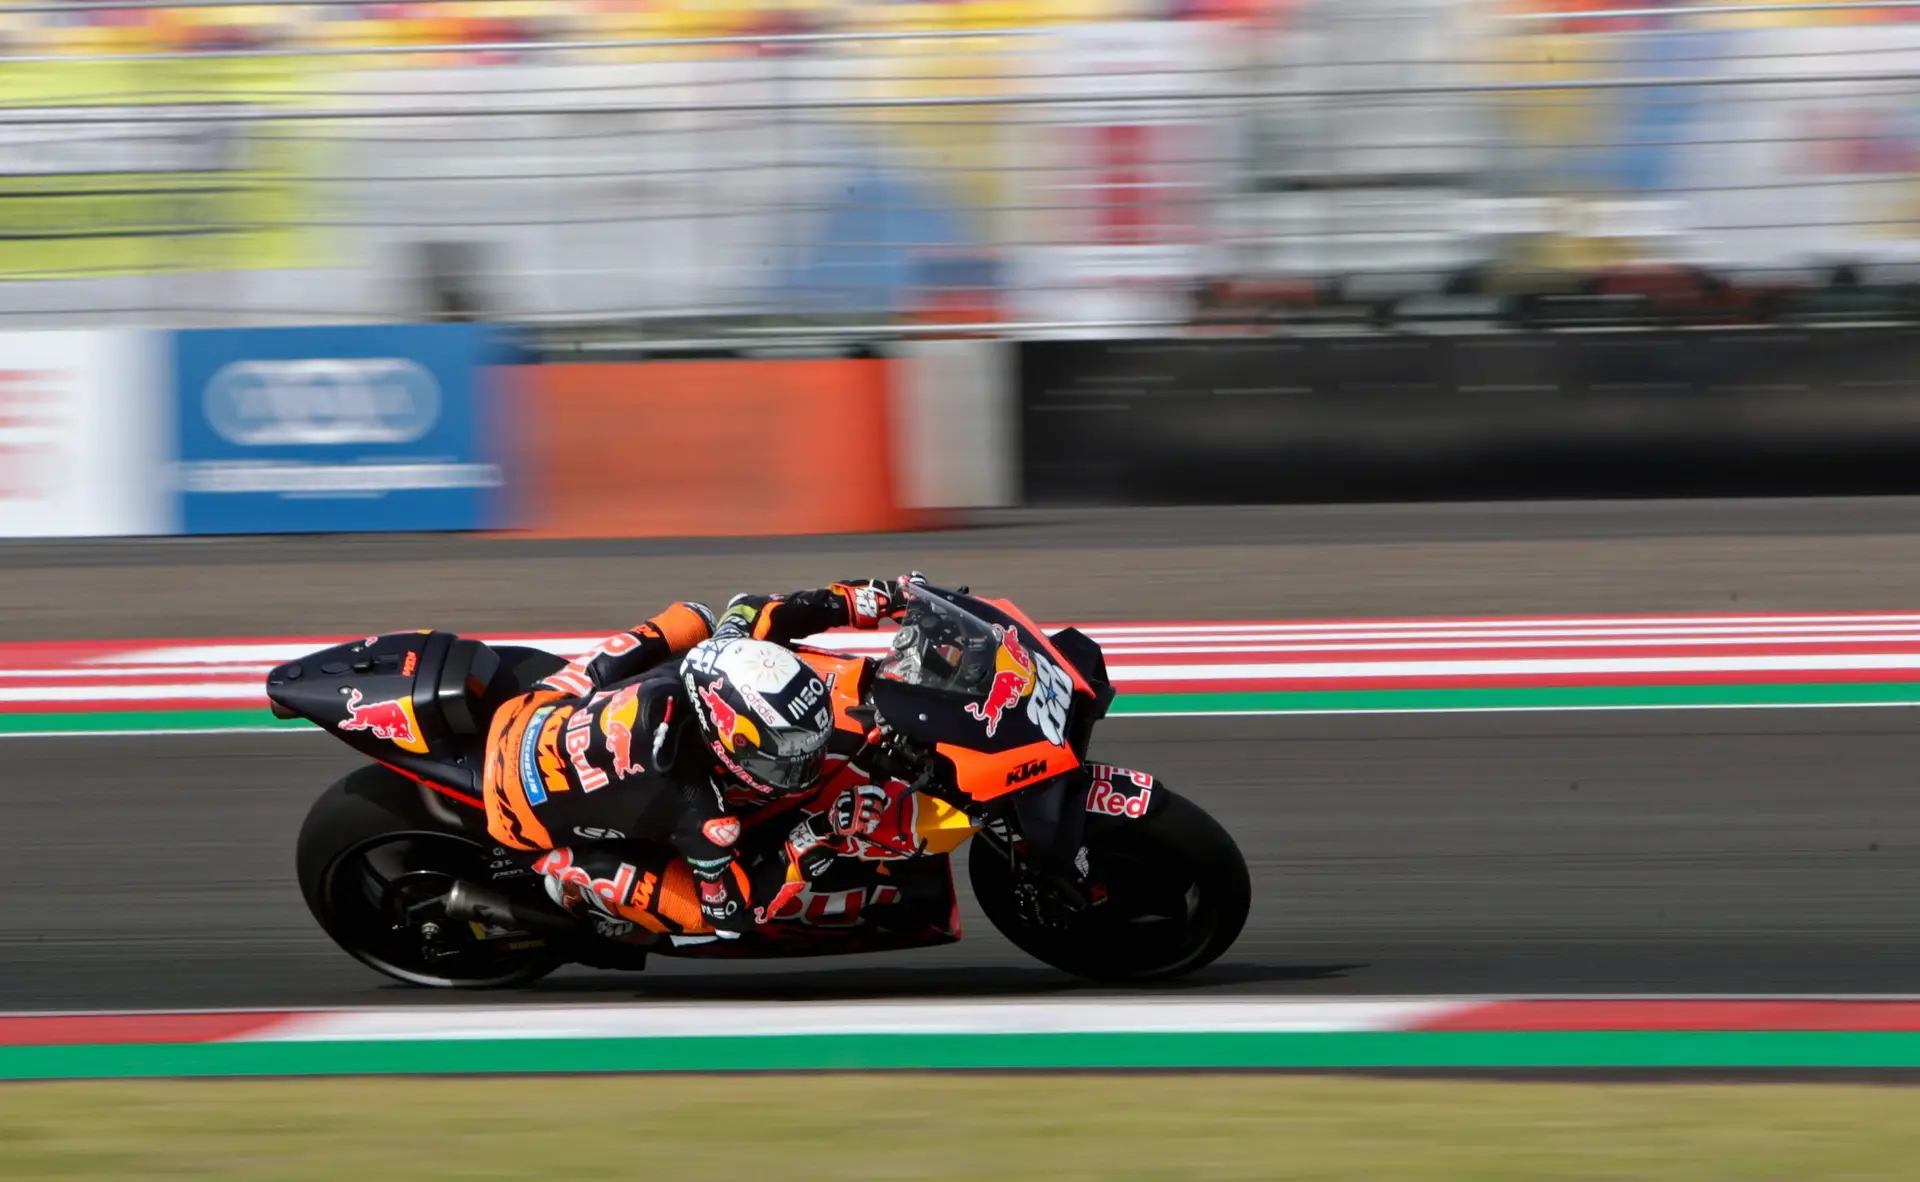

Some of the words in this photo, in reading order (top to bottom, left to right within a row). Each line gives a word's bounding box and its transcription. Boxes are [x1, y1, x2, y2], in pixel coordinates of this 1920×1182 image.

[739, 683, 776, 727] Cofidis
[787, 677, 824, 720] MEO
[1026, 651, 1075, 747] 88
[523, 728, 539, 793] MICHELIN
[565, 725, 610, 794] Bull
[710, 739, 742, 775] Red
[1005, 757, 1048, 788] KTM
[1085, 779, 1152, 819] Red
[701, 900, 738, 920] MEO
